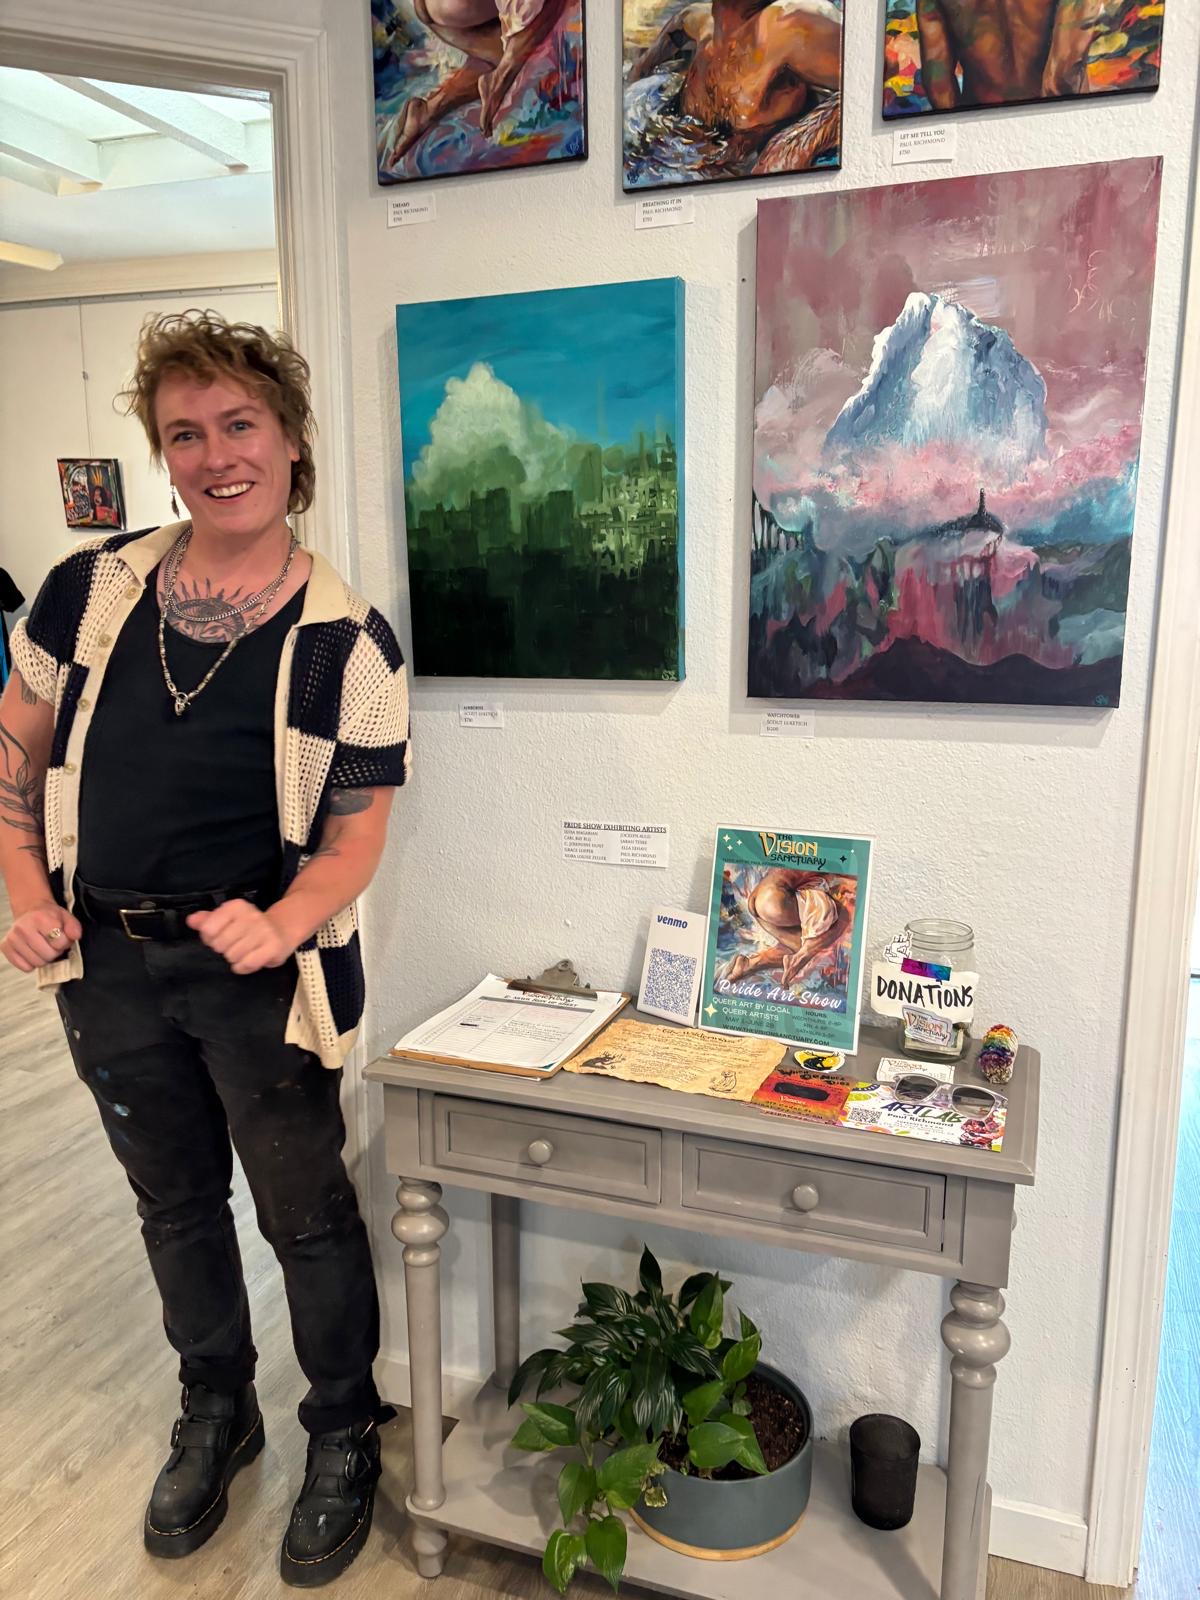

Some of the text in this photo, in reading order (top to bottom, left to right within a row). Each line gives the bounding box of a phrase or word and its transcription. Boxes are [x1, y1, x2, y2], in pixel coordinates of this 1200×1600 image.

[604, 824, 641, 833] EXHIBITING
[642, 826, 667, 834] ARTISTS
[759, 832, 818, 857] VISION
[770, 853, 827, 870] SANCTUARY
[657, 914, 689, 929] venmo
[719, 979, 842, 1009] Pride Art Show
[876, 975, 974, 1010] DONATIONS
[712, 997, 737, 1006] QUEER
[766, 1005, 791, 1014] LOCAL
[722, 1007, 779, 1021] QUEER ARTISTS
[887, 1112, 907, 1120] Paul
[909, 1116, 954, 1127] Richmond
